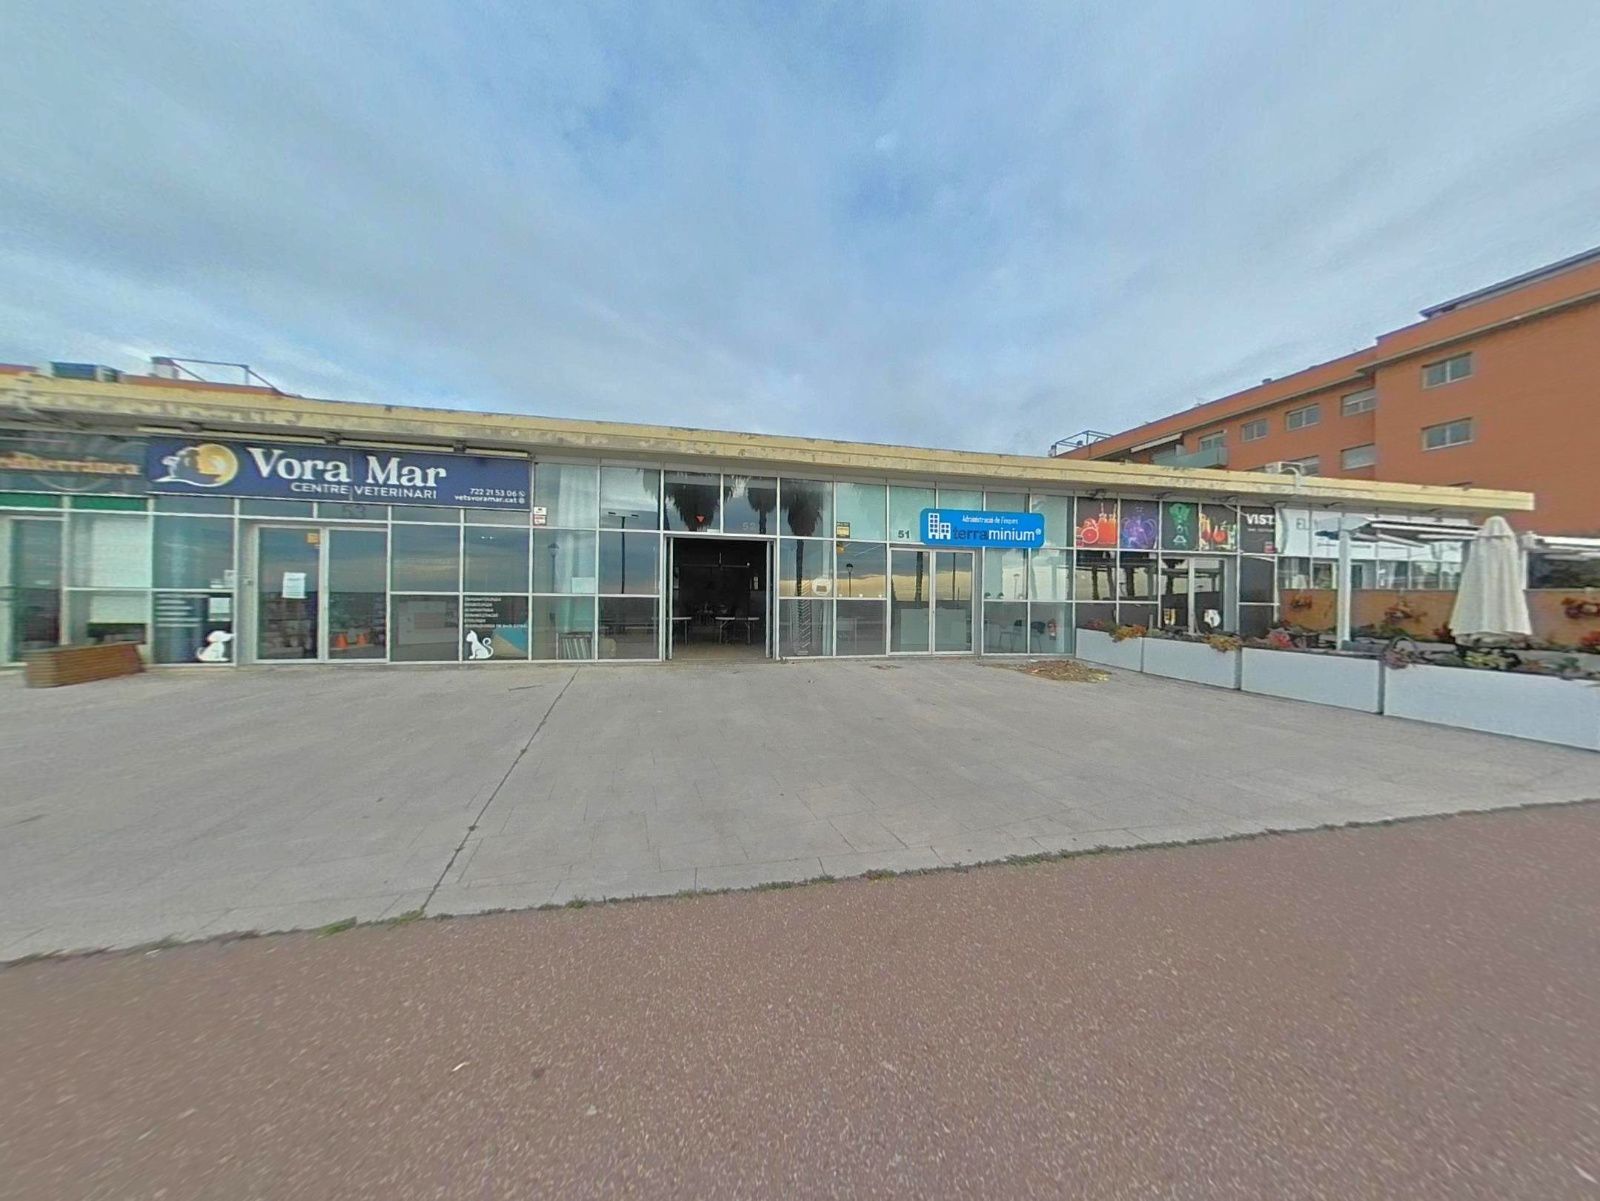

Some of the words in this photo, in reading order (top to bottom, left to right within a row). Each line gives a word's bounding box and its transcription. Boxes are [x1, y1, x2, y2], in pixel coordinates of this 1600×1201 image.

[246, 447, 351, 483] Vora
[366, 455, 447, 488] Mar
[290, 482, 350, 495] CENTRE
[354, 485, 437, 499] VETERINARI
[469, 487, 484, 496] 722
[485, 488, 494, 496] 21
[495, 489, 505, 497] 53
[897, 529, 911, 539] 51
[953, 527, 1035, 542] terraminium
